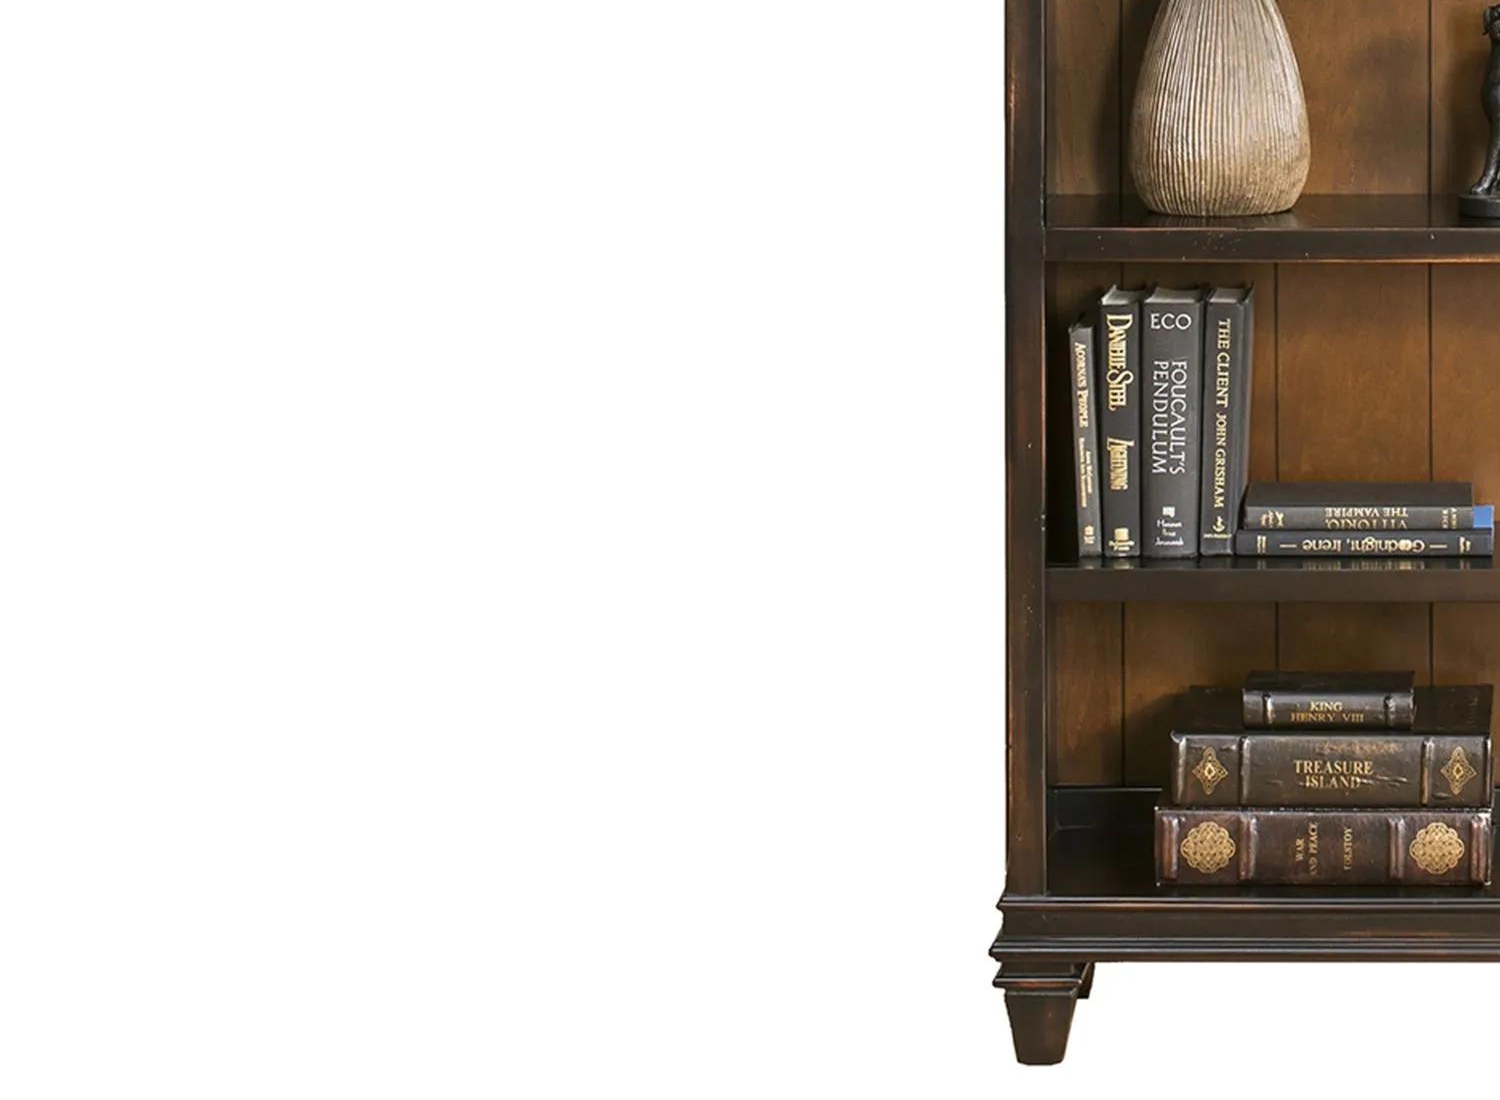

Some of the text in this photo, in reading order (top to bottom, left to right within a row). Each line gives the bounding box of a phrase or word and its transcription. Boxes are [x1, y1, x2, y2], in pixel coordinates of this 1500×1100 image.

[1150, 312, 1193, 331] ECO
[1215, 318, 1232, 408] THE CLIENT
[1152, 360, 1169, 475] PENDULUM
[1168, 360, 1188, 475] FOUCAULT'S
[1213, 412, 1227, 509] JOHN GRISHAM
[1324, 507, 1409, 517] THE VAMPIRE
[1310, 701, 1344, 712] KING
[1290, 712, 1365, 723] HENRY VIII
[1293, 759, 1374, 775] TREASURE
[1303, 775, 1361, 789] ISLAND
